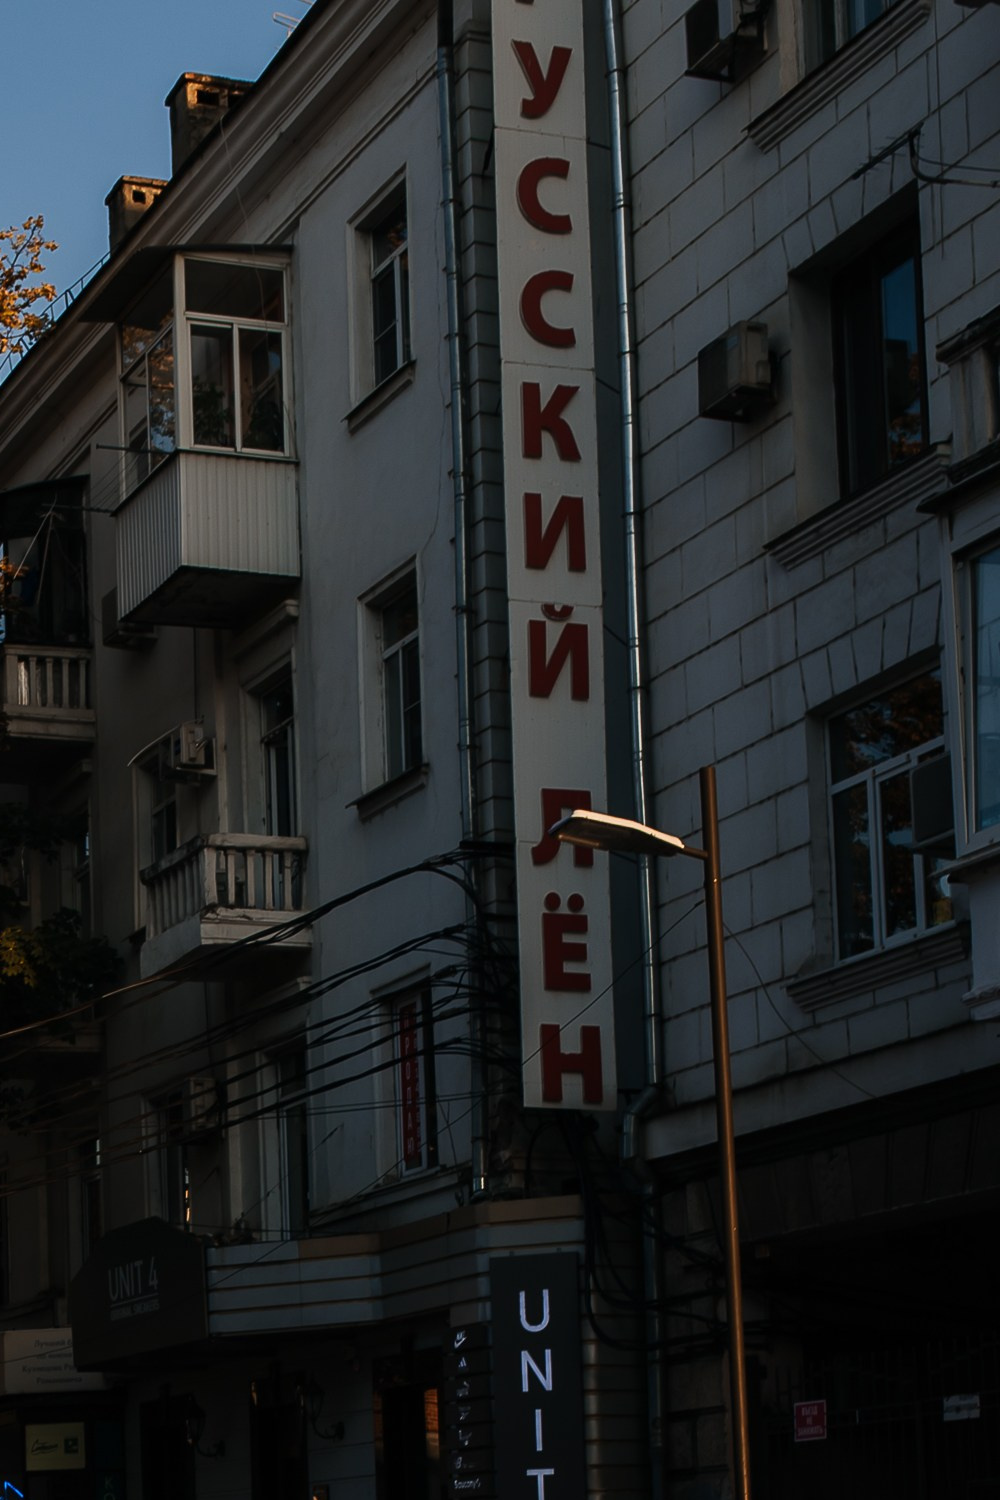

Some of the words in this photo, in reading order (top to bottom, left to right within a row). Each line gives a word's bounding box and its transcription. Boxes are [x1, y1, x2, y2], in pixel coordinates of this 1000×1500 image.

[510, 0, 590, 700] УССКИЙ
[531, 787, 601, 1104] ЛЁН
[108, 1259, 143, 1302] UNIT
[147, 1255, 158, 1290] 4
